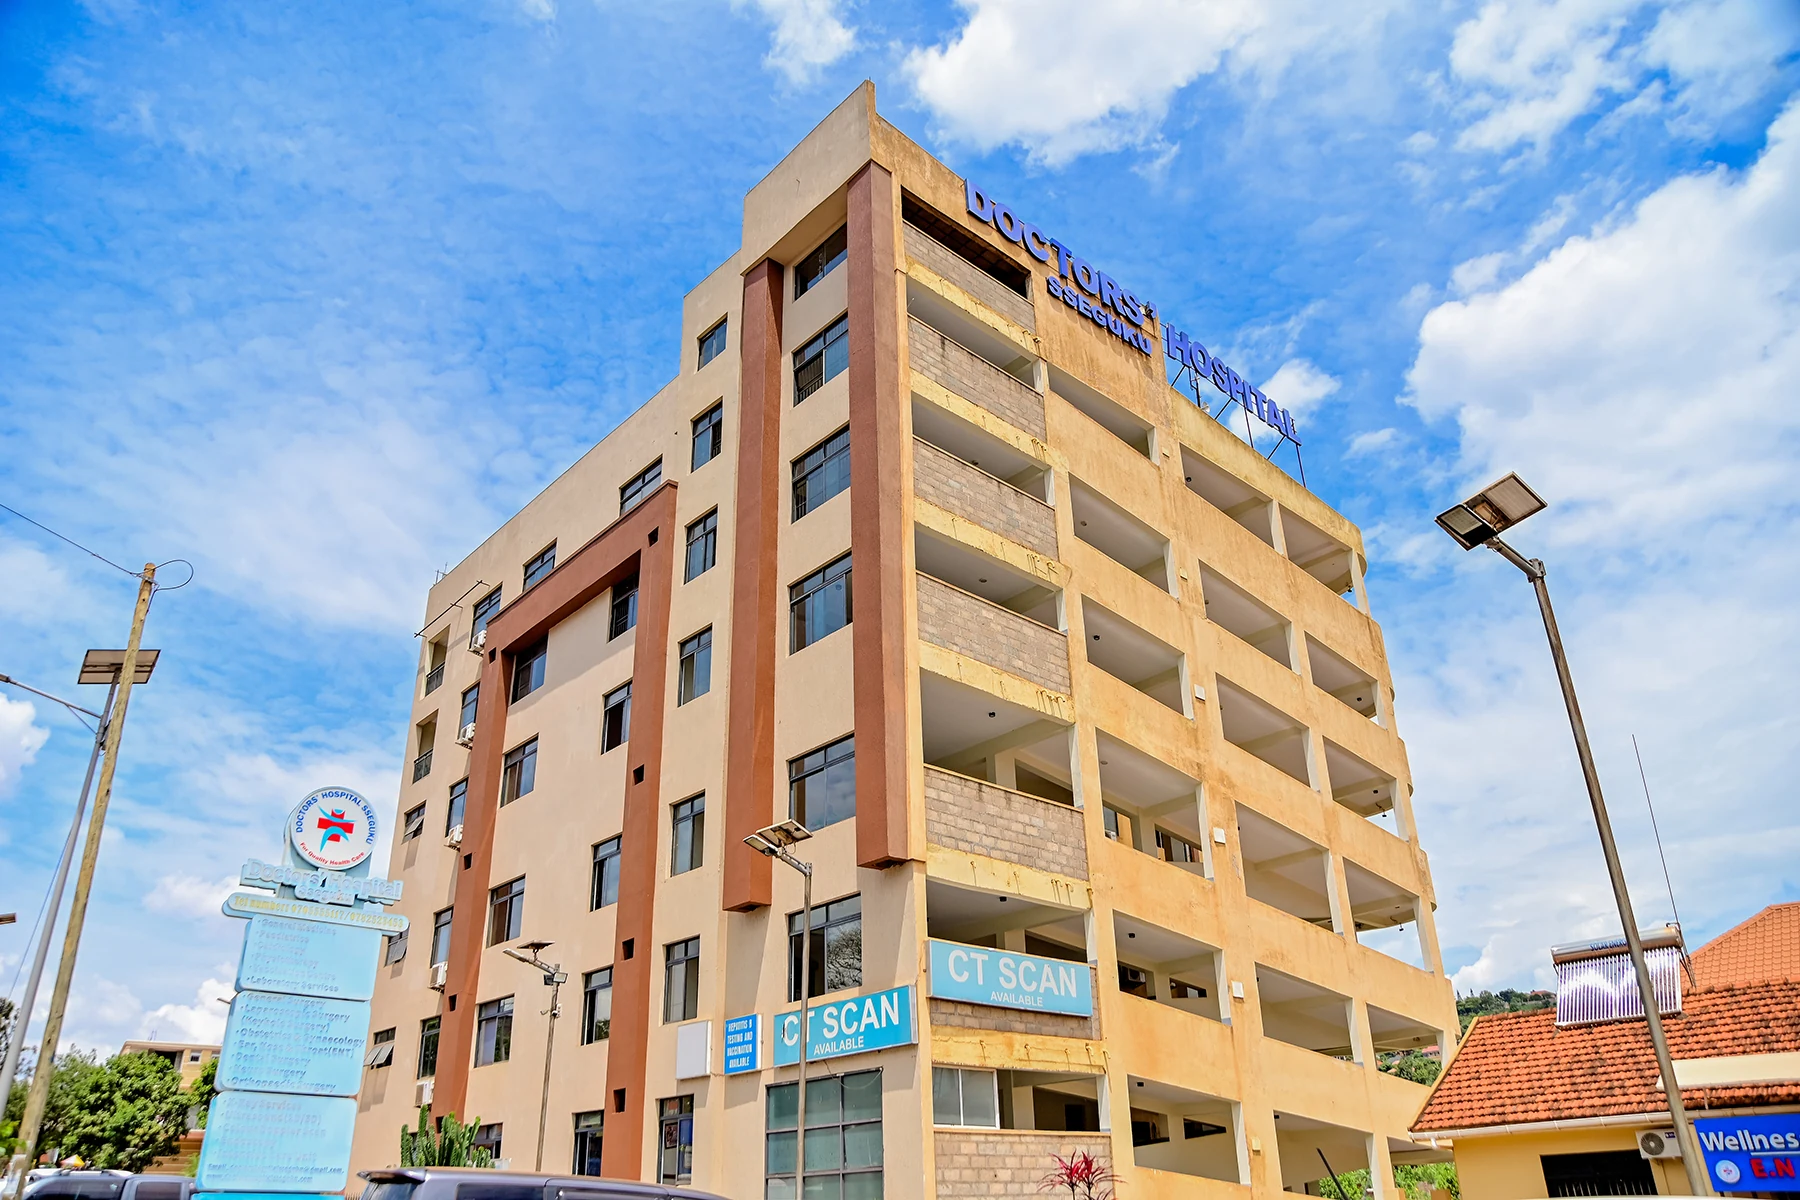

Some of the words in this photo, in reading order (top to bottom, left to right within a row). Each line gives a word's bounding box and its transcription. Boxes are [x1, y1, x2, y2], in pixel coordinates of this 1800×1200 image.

[1046, 275, 1152, 358] SSEGUKU
[1166, 322, 1302, 446] HOSPITAL
[321, 790, 361, 807] HOSPITAL
[361, 805, 376, 845] SSEGUKU
[300, 842, 308, 852] For
[308, 851, 328, 865] Quality
[351, 851, 365, 862] Care
[329, 873, 400, 897] Hospital
[948, 949, 989, 985] CT
[999, 957, 1077, 998] SCAN
[251, 975, 300, 990] Laboratory
[301, 981, 339, 993] Services
[247, 992, 285, 1003] General
[287, 997, 327, 1011] Surgery
[990, 991, 1043, 1007] AVAILABLE
[313, 1009, 351, 1023] Surgery
[822, 992, 900, 1039] SCAN
[303, 1033, 365, 1048] Gynaecology
[727, 1033, 743, 1044] TESTING
[813, 1036, 864, 1056] AVAILABLE
[271, 1056, 311, 1068] Surgery
[729, 1056, 750, 1068] AVAILABLE
[268, 1067, 307, 1080] Surgery
[298, 1080, 337, 1093] Surgery
[1699, 1129, 1800, 1152] Wellnes
